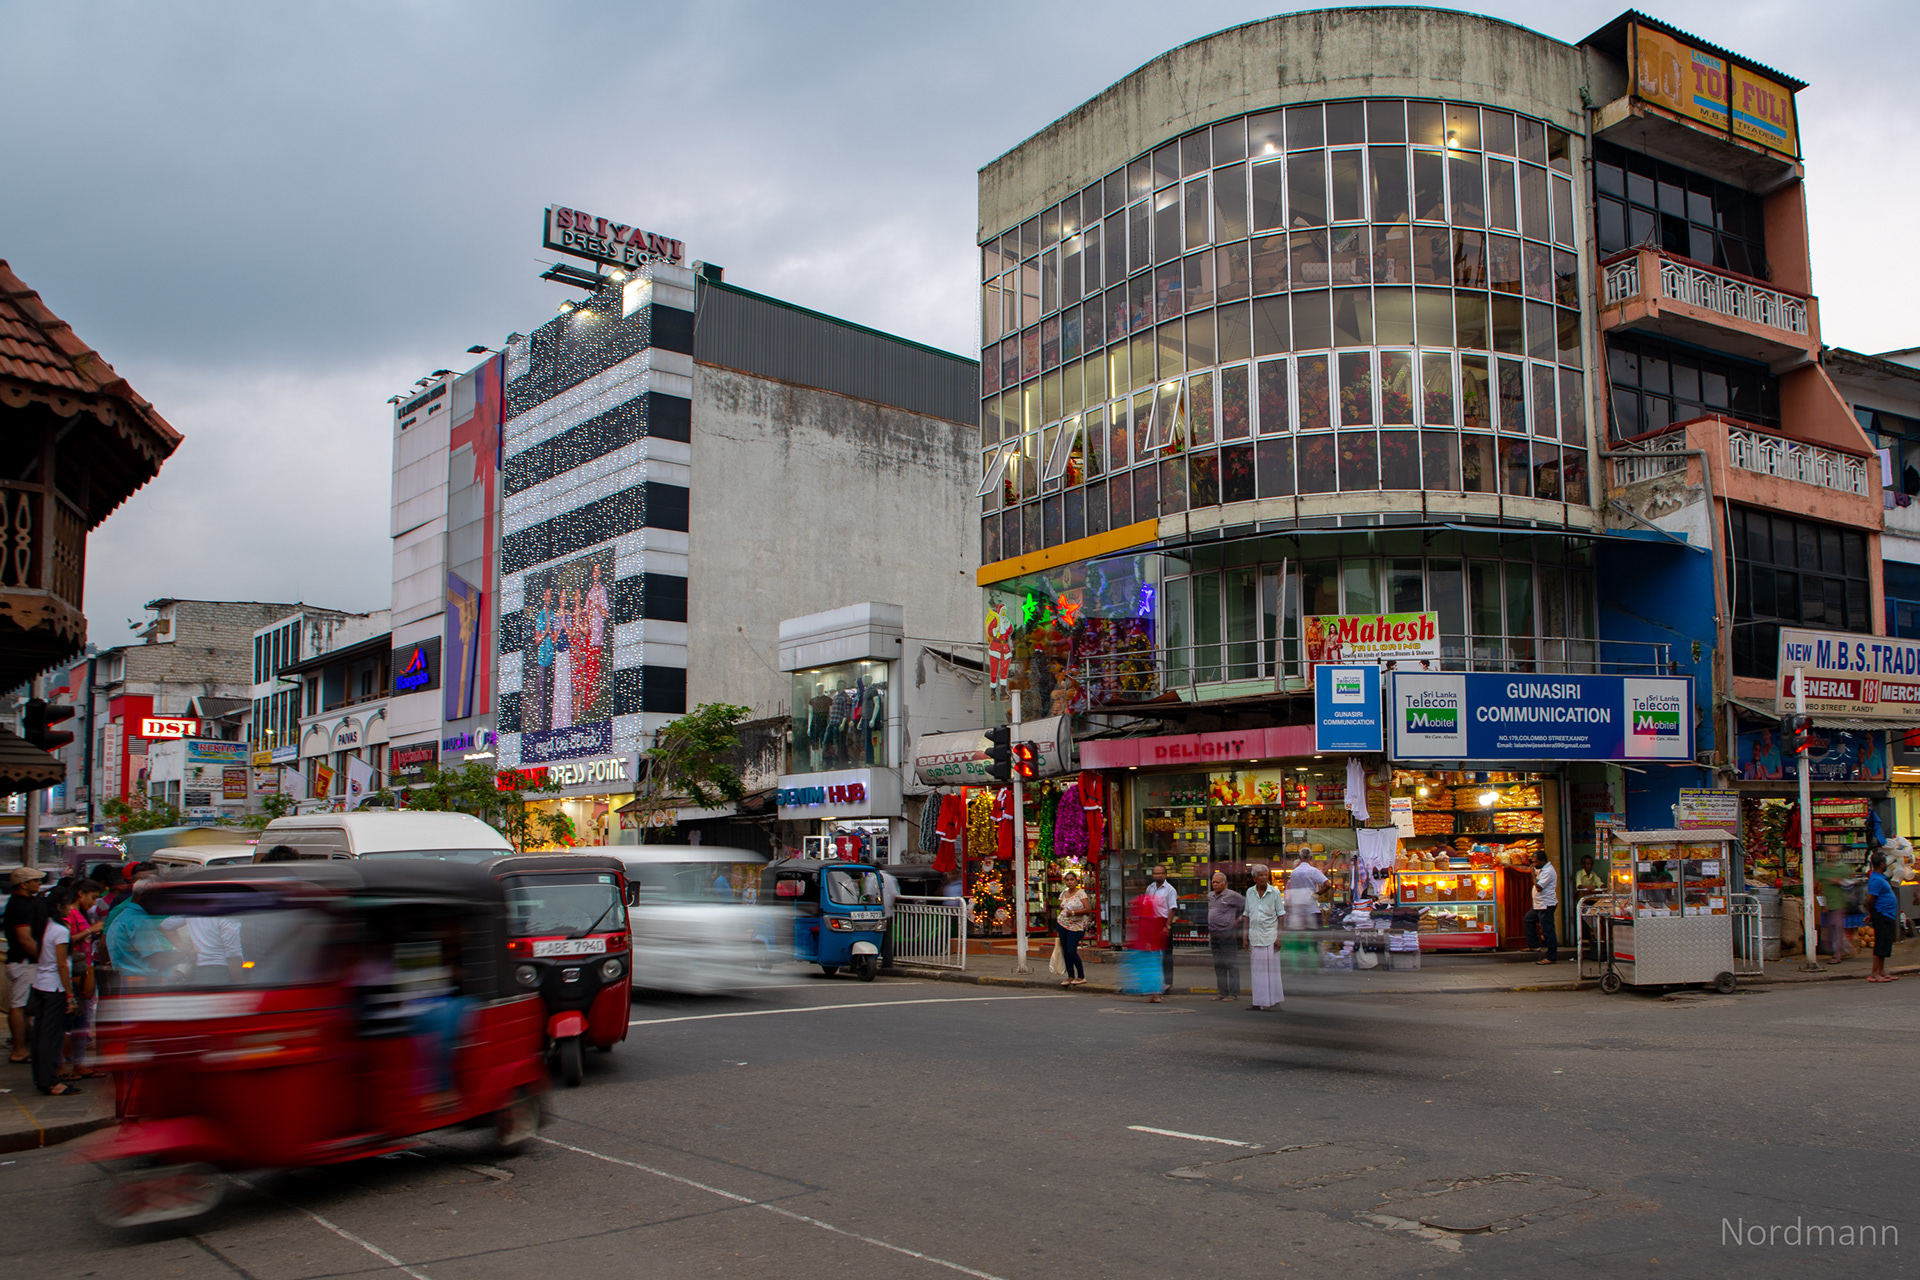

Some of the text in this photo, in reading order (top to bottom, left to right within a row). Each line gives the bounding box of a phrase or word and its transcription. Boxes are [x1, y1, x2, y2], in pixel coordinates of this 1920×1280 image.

[1692, 61, 1737, 103] TOP
[1737, 121, 1783, 144] TRADERS
[558, 207, 681, 260] SRIYANI
[563, 230, 618, 258] DRESS
[1336, 614, 1435, 644] Mahesh
[1352, 643, 1421, 652] TAILORING
[1786, 639, 1920, 675] NEW M.B.S.TRAD
[1507, 683, 1581, 699] GUNASIRI
[1864, 680, 1878, 702] 181
[1405, 693, 1458, 708] Telecom
[1633, 697, 1680, 711] Telecom
[1785, 702, 1819, 711] COMBO
[1821, 704, 1847, 712] STREET
[1852, 705, 1875, 713] KANDY
[1410, 712, 1455, 729] Mobitel
[1476, 706, 1611, 723] COMMUNICATION
[148, 722, 194, 735] DSI
[1637, 715, 1677, 731] Mobitel
[338, 731, 357, 745] PAIVAS
[199, 743, 238, 753] REKHA
[1155, 740, 1245, 758] DELIGHT
[918, 752, 976, 766] BEAUTY
[550, 763, 587, 785] DRESS
[926, 763, 961, 779] ගුණසිරි
[776, 782, 865, 806] DENIM HUB
[574, 940, 604, 953] 7940
